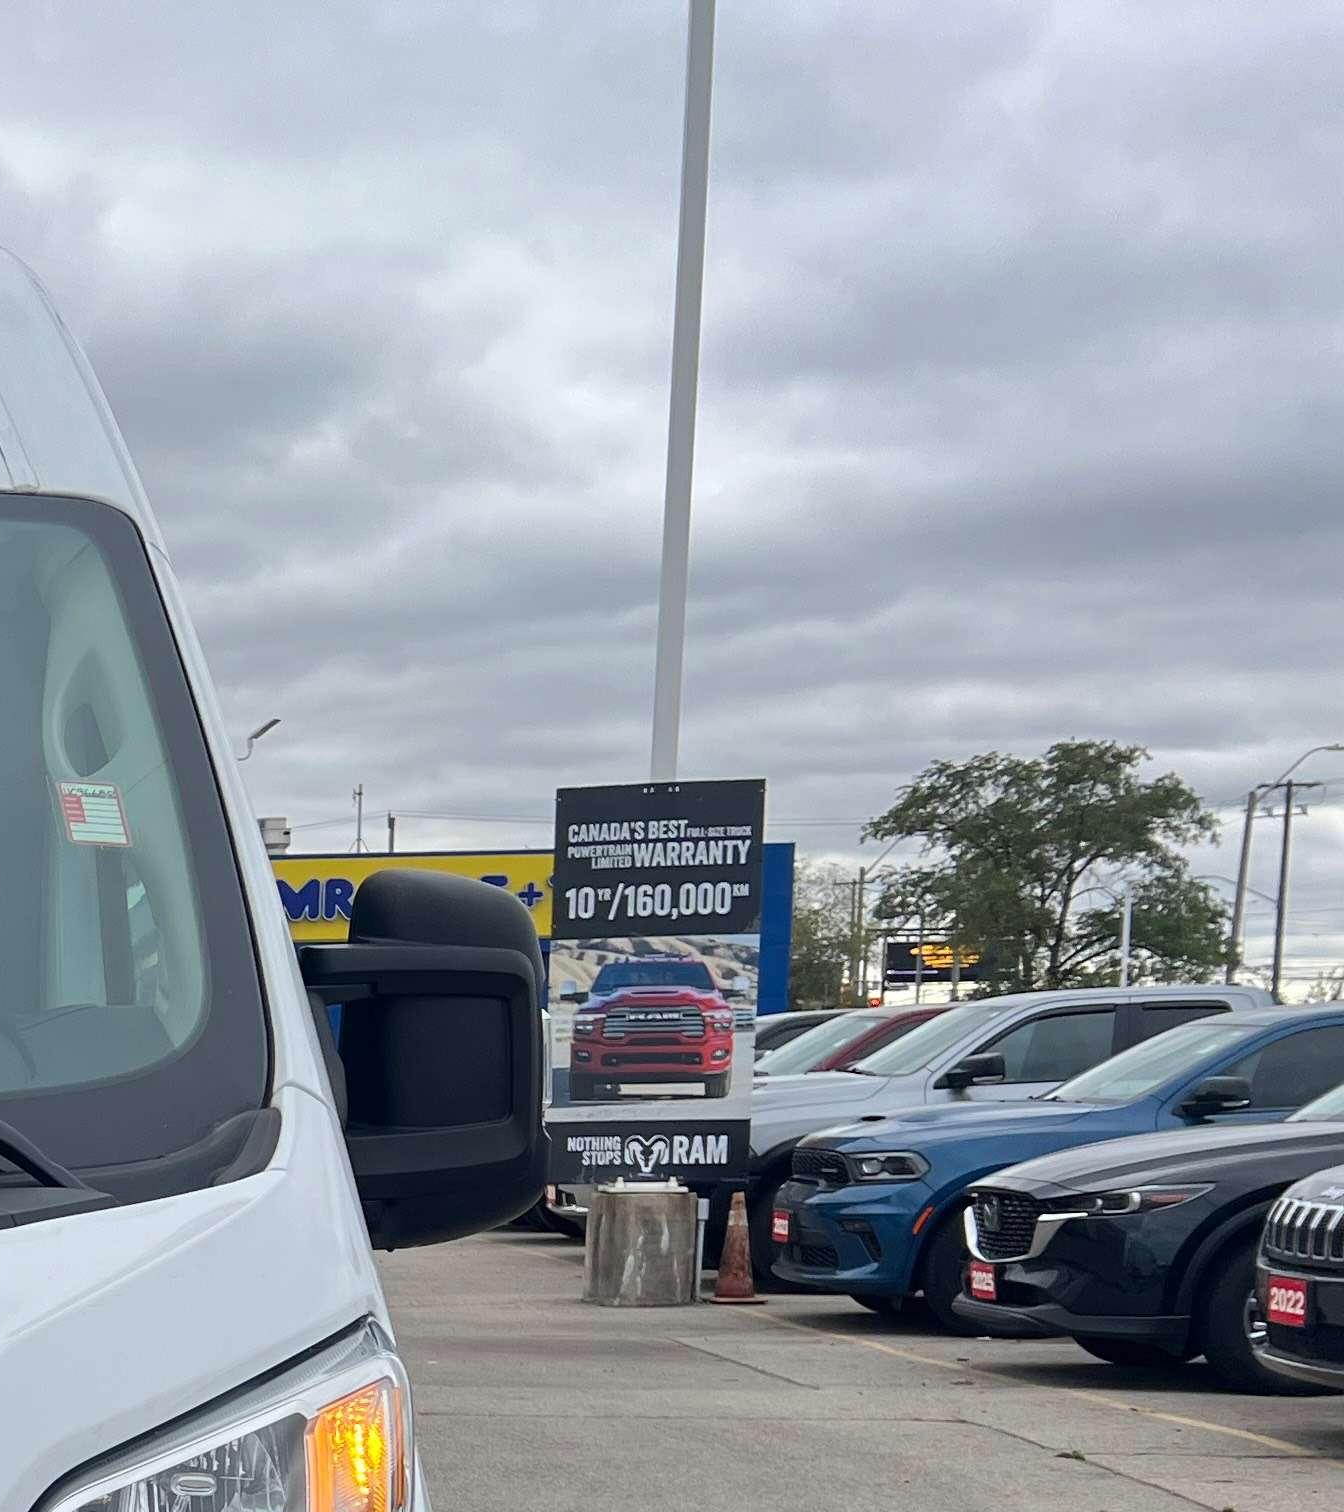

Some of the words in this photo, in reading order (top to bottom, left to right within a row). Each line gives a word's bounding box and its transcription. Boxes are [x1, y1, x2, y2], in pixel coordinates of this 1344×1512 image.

[568, 821, 645, 843] CANADA'S
[648, 819, 689, 840] BEST
[727, 825, 752, 836] TRUCK
[567, 844, 632, 859] POWERTRAIN
[633, 839, 751, 868] WARRANTY
[592, 855, 632, 869] LIMITED
[567, 1136, 621, 1151] NOTHING
[581, 1150, 621, 1166] STOPS
[672, 1135, 729, 1165] RAM
[1270, 1286, 1305, 1315] 2022
